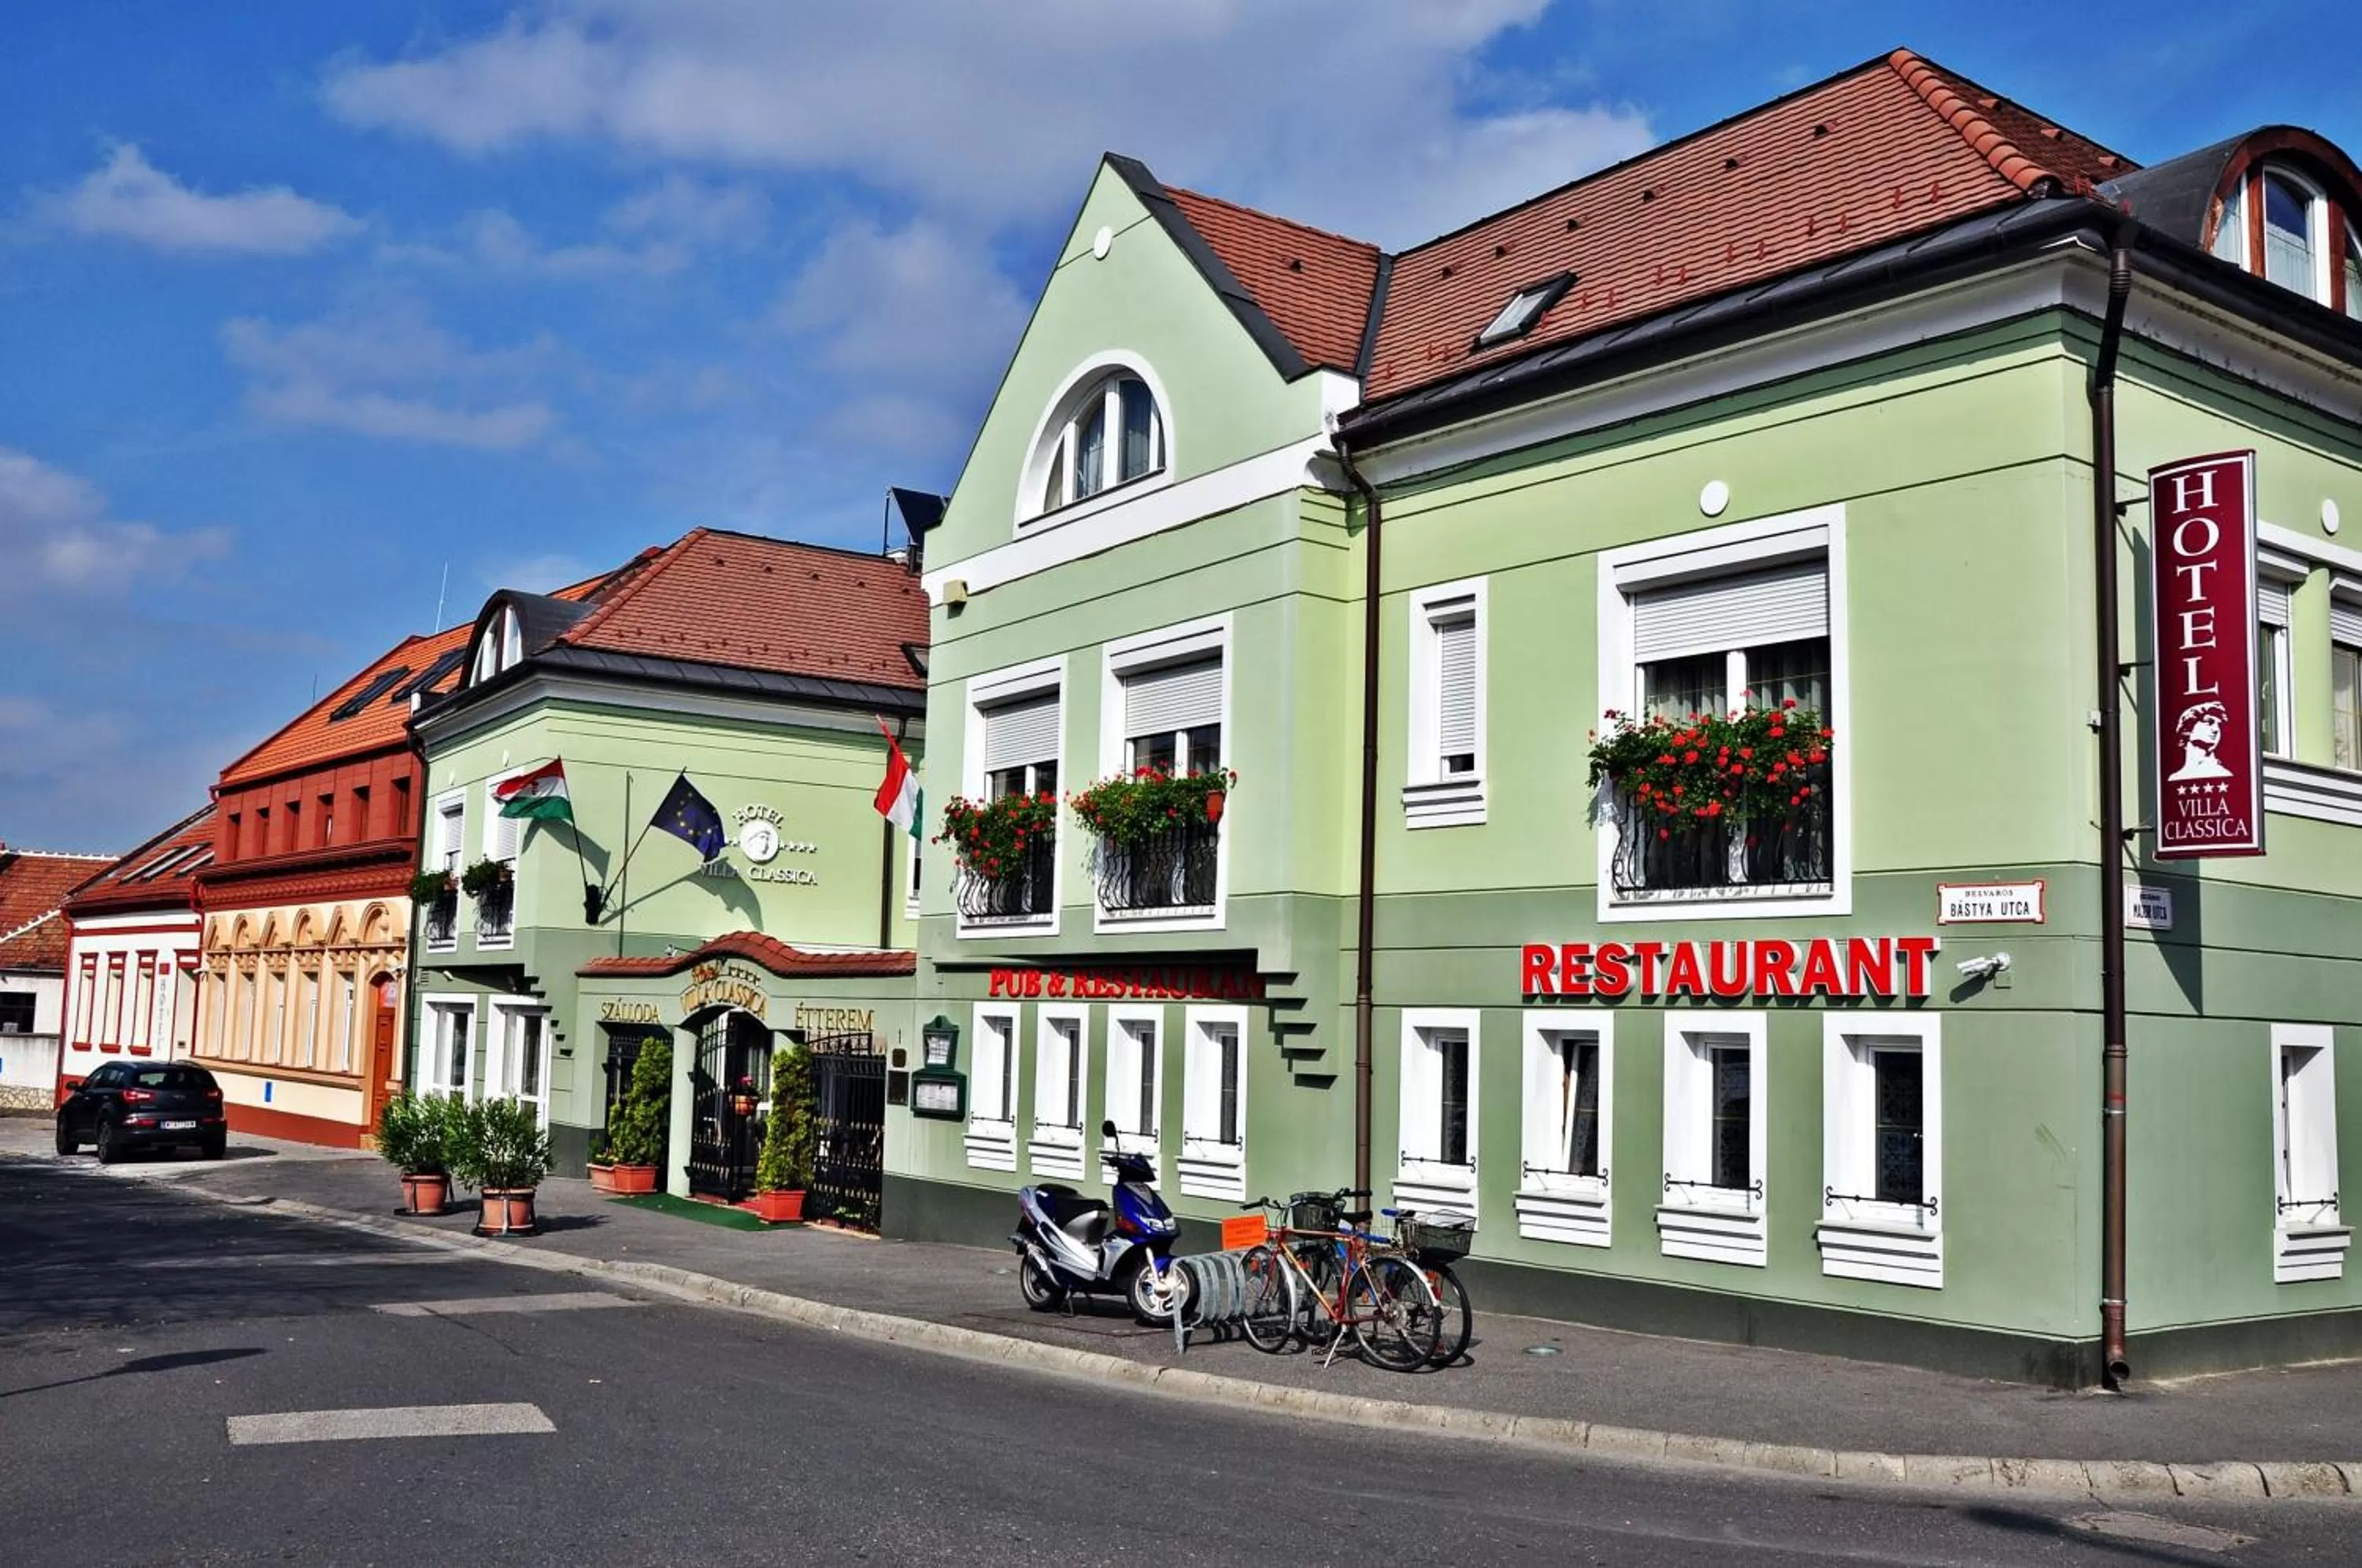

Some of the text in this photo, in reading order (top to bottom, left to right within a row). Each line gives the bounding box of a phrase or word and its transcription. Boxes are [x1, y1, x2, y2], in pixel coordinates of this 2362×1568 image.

[2171, 470, 2219, 696] HOTEL
[732, 804, 784, 829] HOTEL
[2178, 797, 2230, 817] VILLA
[2164, 818, 2249, 840] CLASSICA
[700, 863, 818, 886] VILLA CLASSICA
[2001, 901, 2031, 916] UTCA
[1521, 937, 1940, 997] RESTAURANT
[989, 963, 1265, 1000] PUB & RESTAURAN
[601, 997, 661, 1023] SZÁLLODA
[715, 979, 768, 1020] CLASSICA
[794, 1000, 876, 1032] ÉTTEREM
